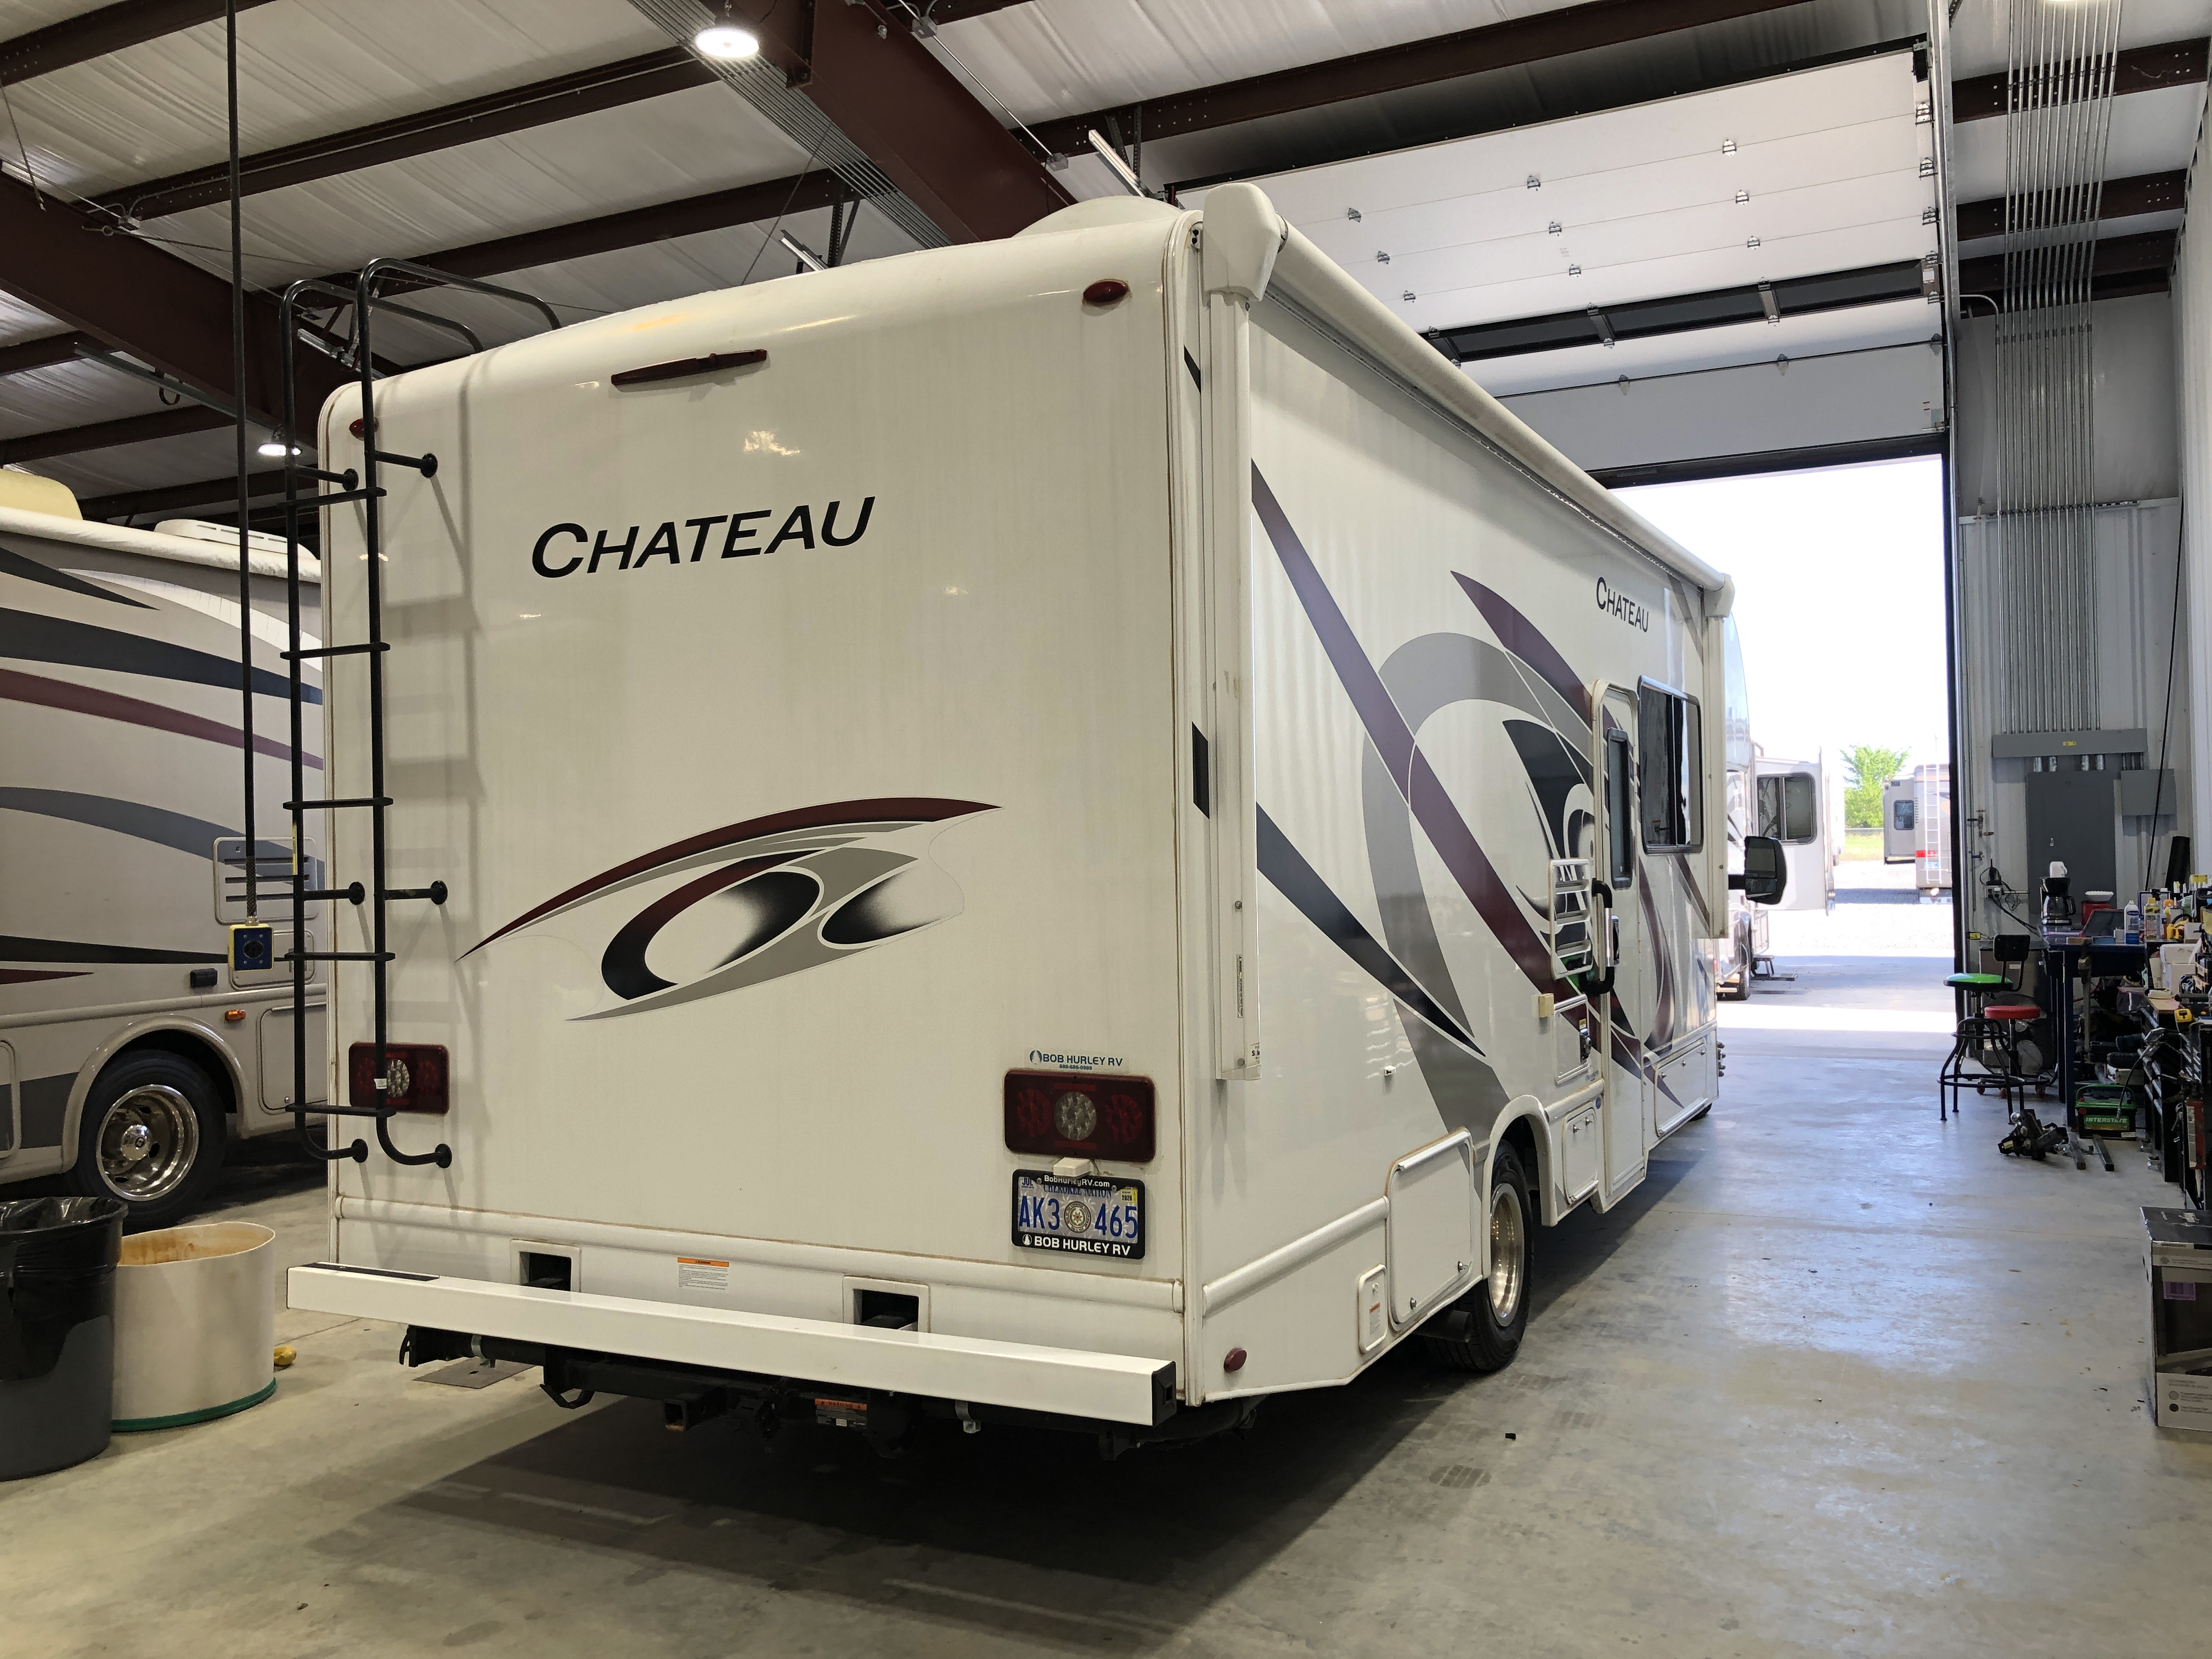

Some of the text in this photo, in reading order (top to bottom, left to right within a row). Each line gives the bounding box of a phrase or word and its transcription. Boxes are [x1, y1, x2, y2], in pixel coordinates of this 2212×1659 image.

[532, 496, 876, 578] CHATEAU
[1596, 577, 1649, 633] CHATEAU
[1043, 1053, 1123, 1066] BOB HURLEY RV
[1044, 1175, 1110, 1187] BobHurleyRV.com
[1019, 1195, 1060, 1231] AK3
[1094, 1203, 1138, 1239] 465
[1034, 1235, 1131, 1256] BOB HURLEY RV
